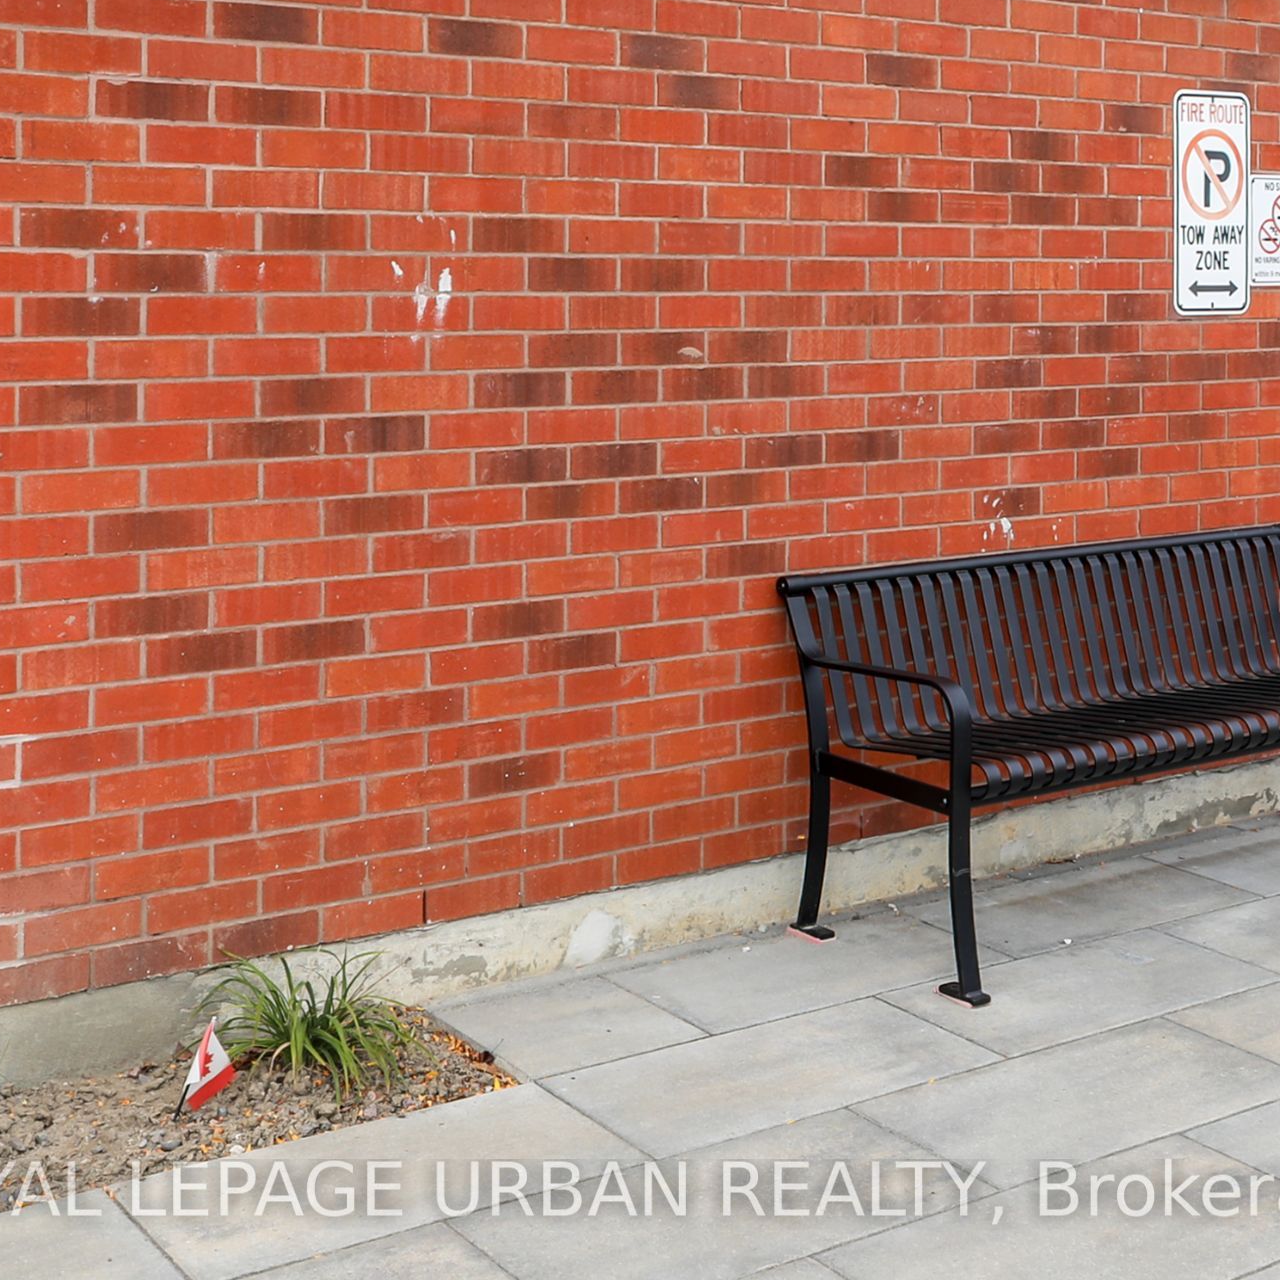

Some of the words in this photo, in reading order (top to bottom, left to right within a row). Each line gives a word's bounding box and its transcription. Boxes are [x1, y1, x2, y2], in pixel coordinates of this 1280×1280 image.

[1180, 102, 1205, 122] FIRE
[1209, 103, 1244, 124] ROUTE
[1265, 182, 1275, 191] NO
[1180, 225, 1205, 245] TOW
[1212, 225, 1244, 245] AWAY
[1195, 250, 1230, 270] ZONE
